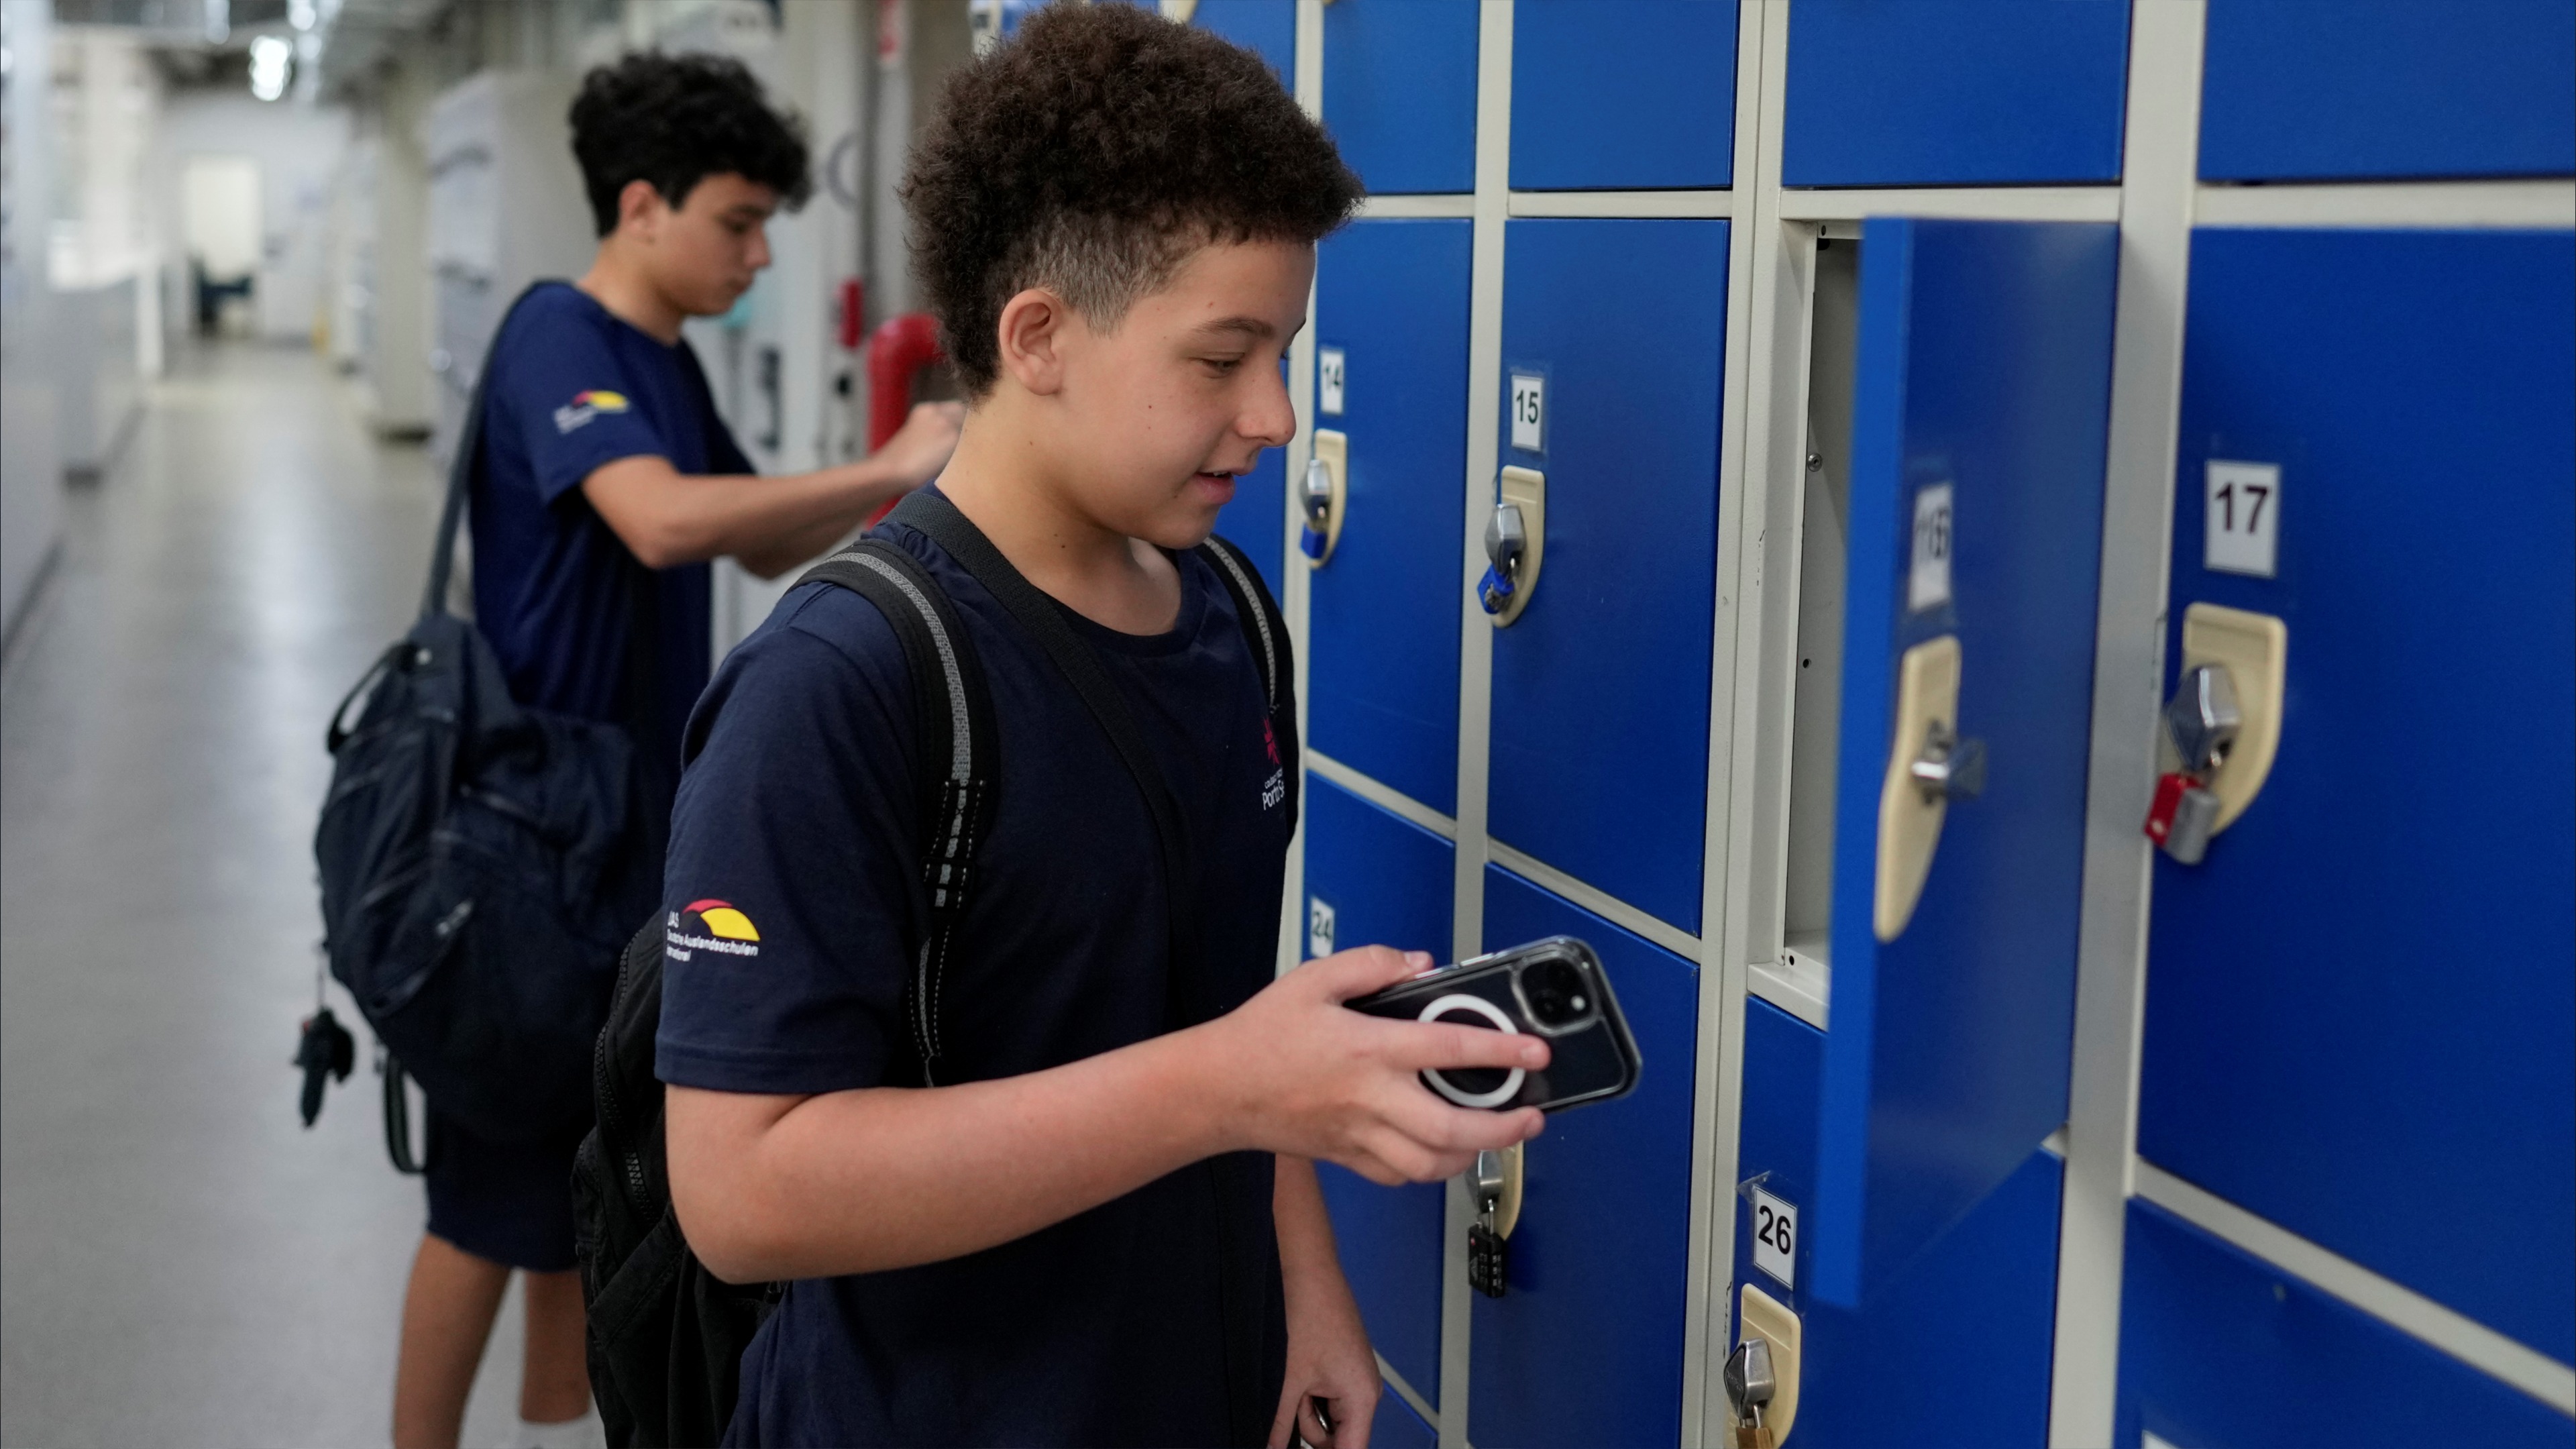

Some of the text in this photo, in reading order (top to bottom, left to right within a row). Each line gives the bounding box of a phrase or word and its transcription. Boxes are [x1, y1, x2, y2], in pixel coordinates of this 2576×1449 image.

[1324, 364, 1343, 390] 14
[1515, 389, 1539, 424] 15
[2216, 482, 2271, 534] 17
[1312, 910, 1332, 941] 24
[1758, 1205, 1791, 1255] 26
